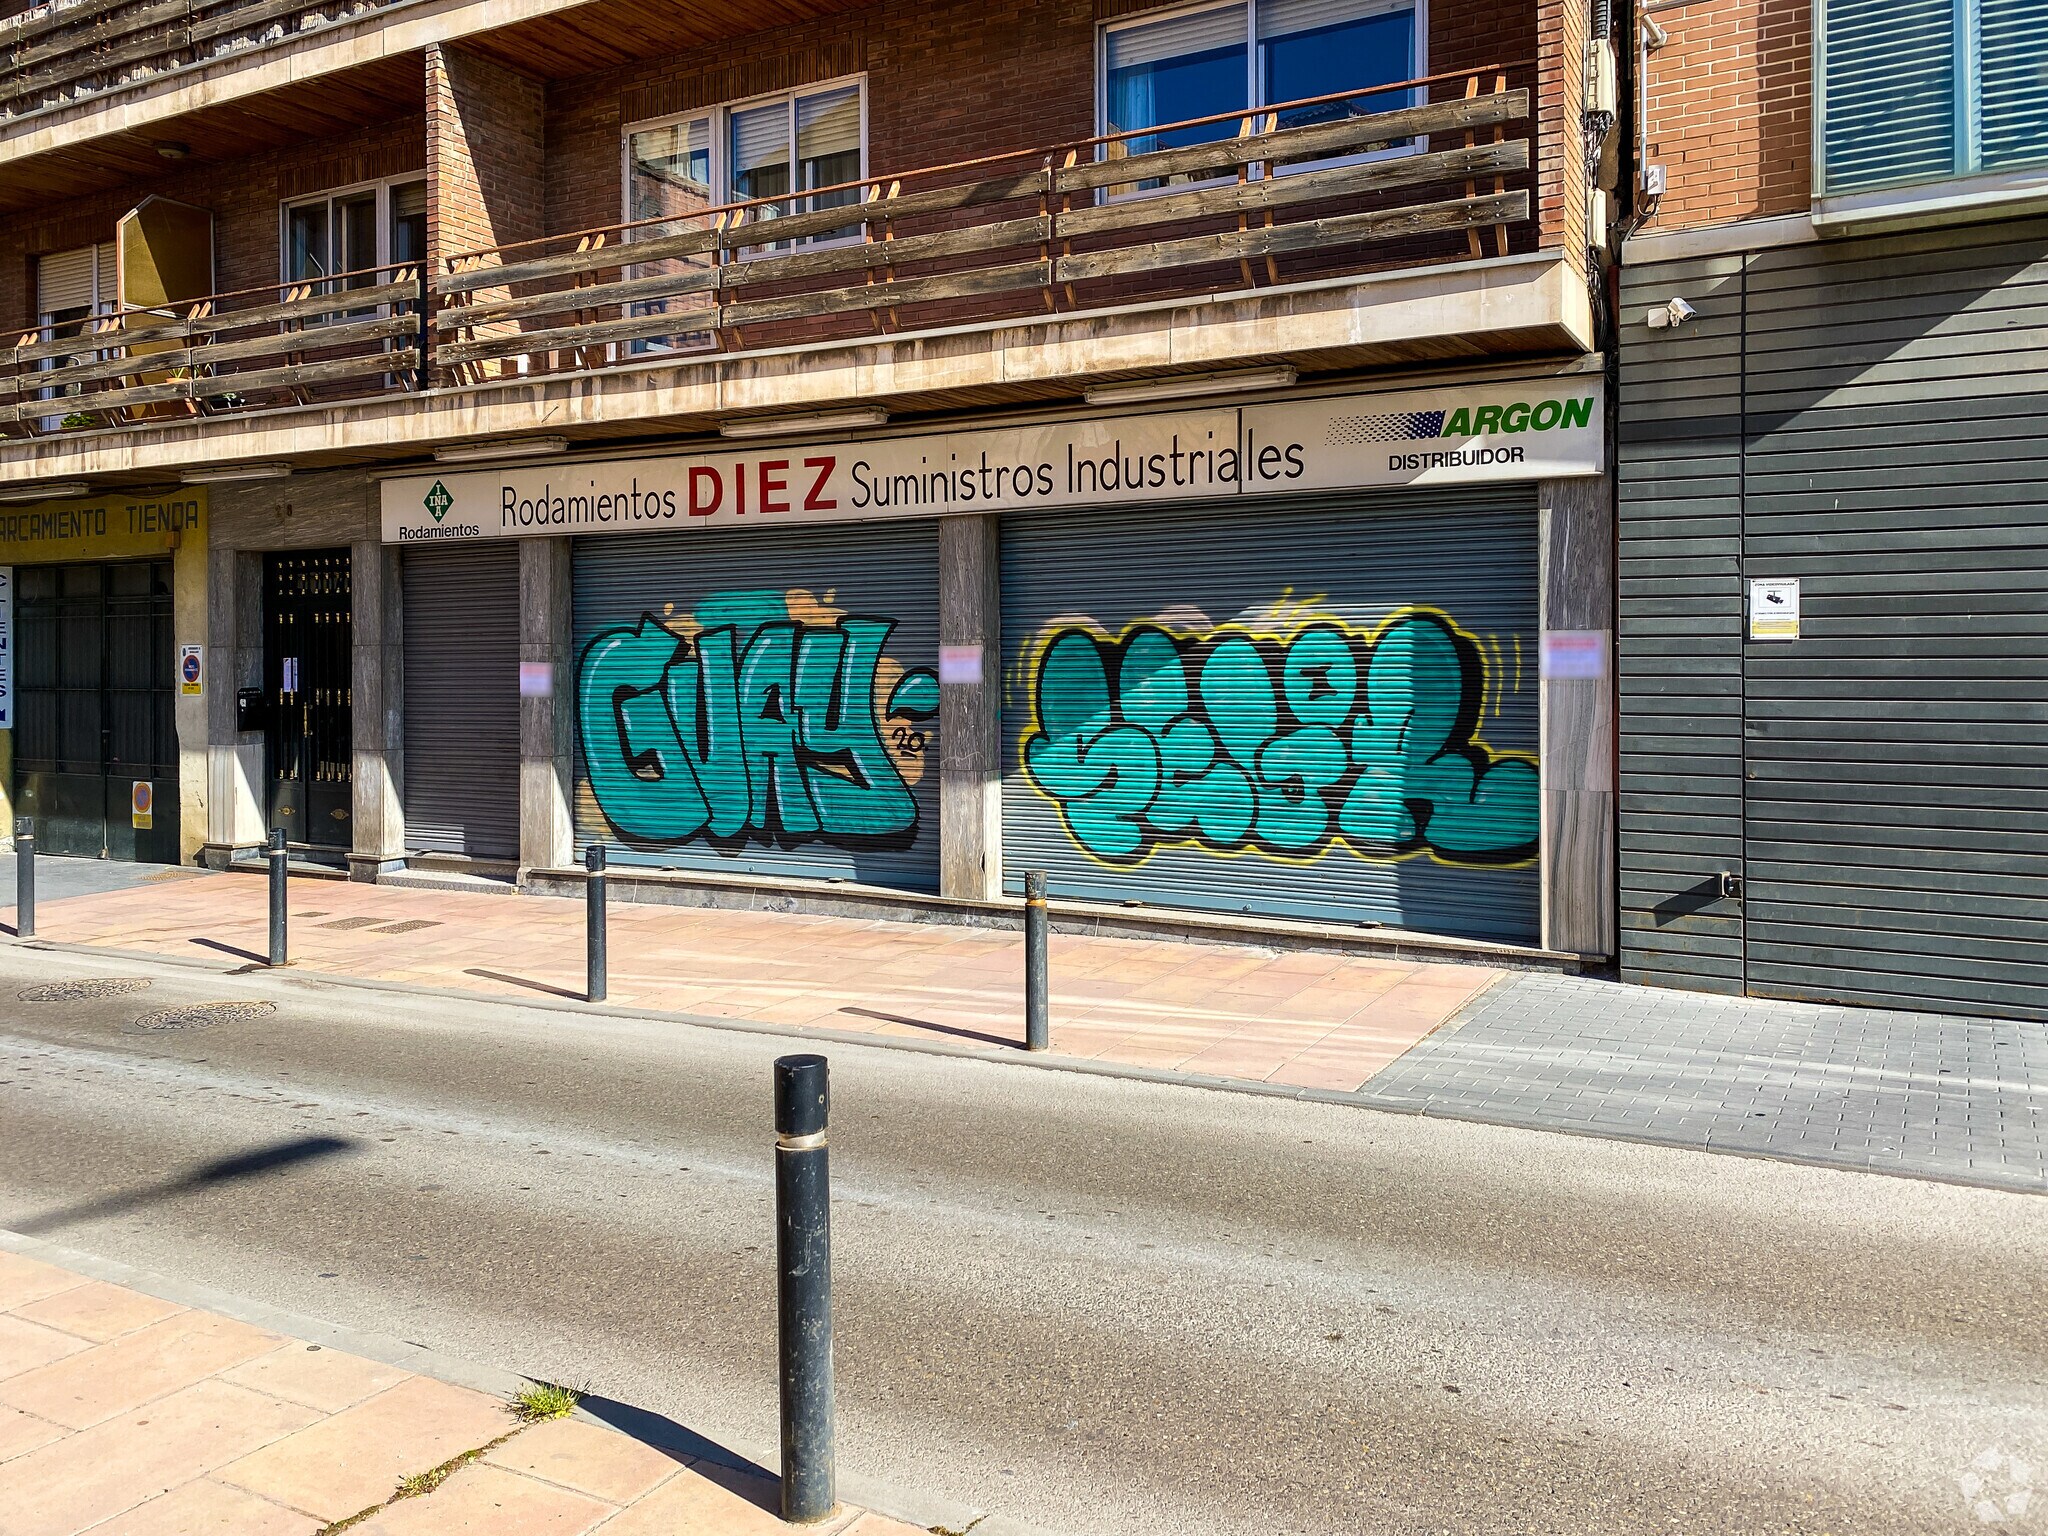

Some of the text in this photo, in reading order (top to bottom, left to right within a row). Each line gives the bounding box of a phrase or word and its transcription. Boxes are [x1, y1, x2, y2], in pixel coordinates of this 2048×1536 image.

[1440, 397, 1595, 438] ARGON
[1388, 446, 1525, 471] DISTRIBUIDOR
[501, 427, 1305, 527] Rodamientos DIEZ Suministros Industriales
[126, 500, 198, 534] TIENDA
[399, 523, 480, 540] Rodamientos
